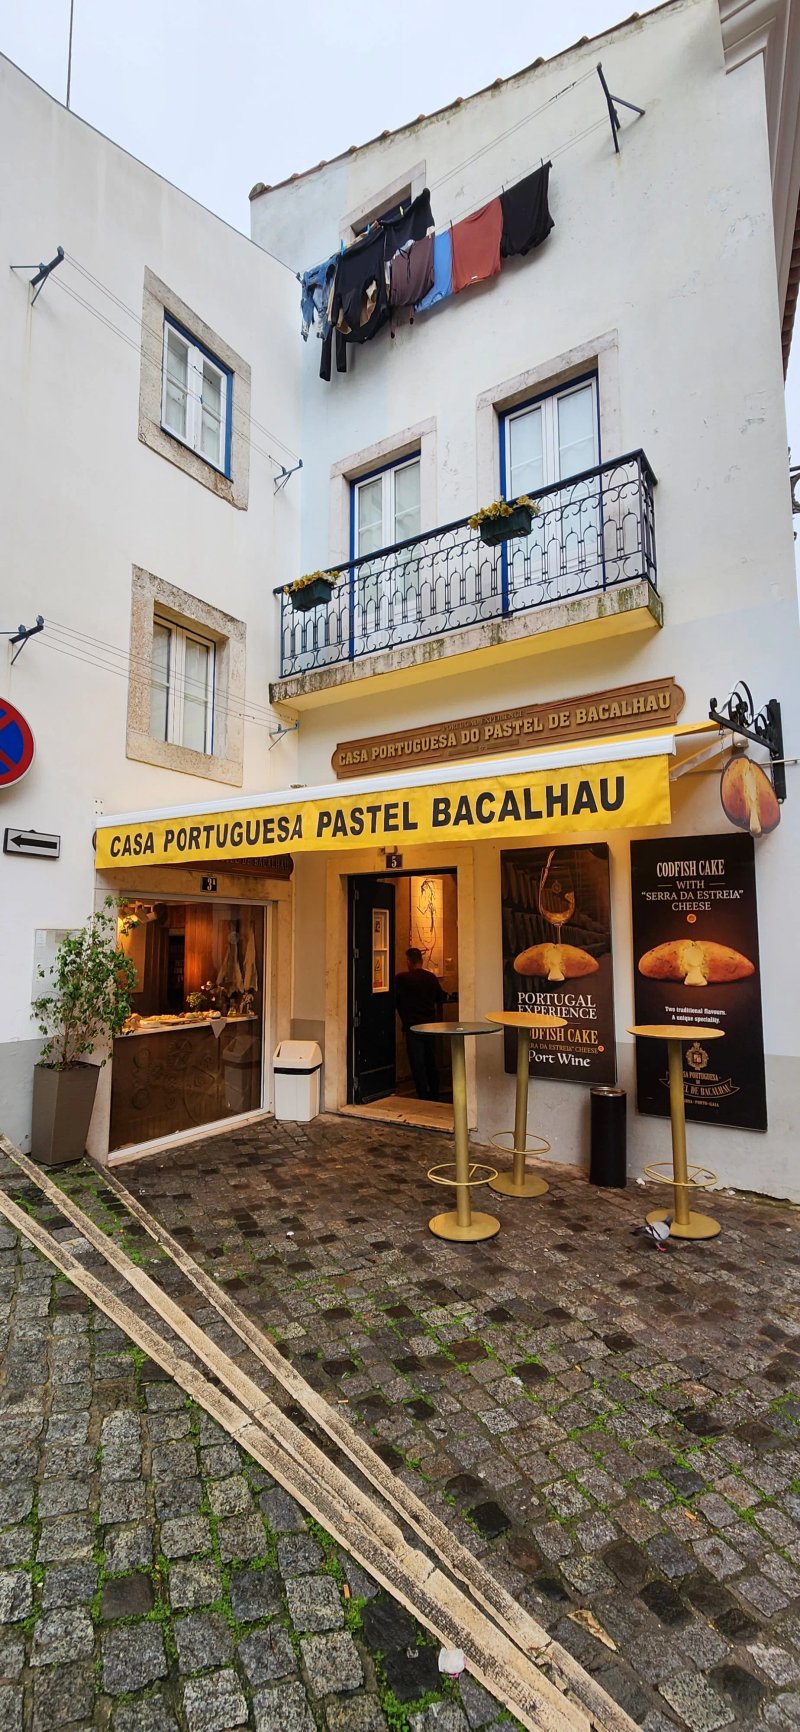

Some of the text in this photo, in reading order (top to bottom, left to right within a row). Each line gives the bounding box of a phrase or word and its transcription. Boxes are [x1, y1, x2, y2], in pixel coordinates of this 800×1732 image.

[338, 691, 671, 766] CASA PORTUGUESA DO PASTEL DE BACALHAU
[110, 776, 625, 858] CASA PORTUGUESA PASTEL BACALHAU
[391, 855, 397, 868] 5
[656, 859, 725, 878] CODFISH CAKE
[676, 880, 705, 889] WITH
[680, 891, 694, 900] DA
[671, 901, 712, 911] CHEESE
[517, 991, 598, 1020] PORTUGAL EXPERIENCE
[676, 1006, 703, 1014] traditional
[694, 1016, 721, 1024] speciality.
[529, 1028, 598, 1044] DFISH CAKE
[575, 1046, 598, 1054] CHEESE
[528, 1050, 591, 1067] Port Wine
